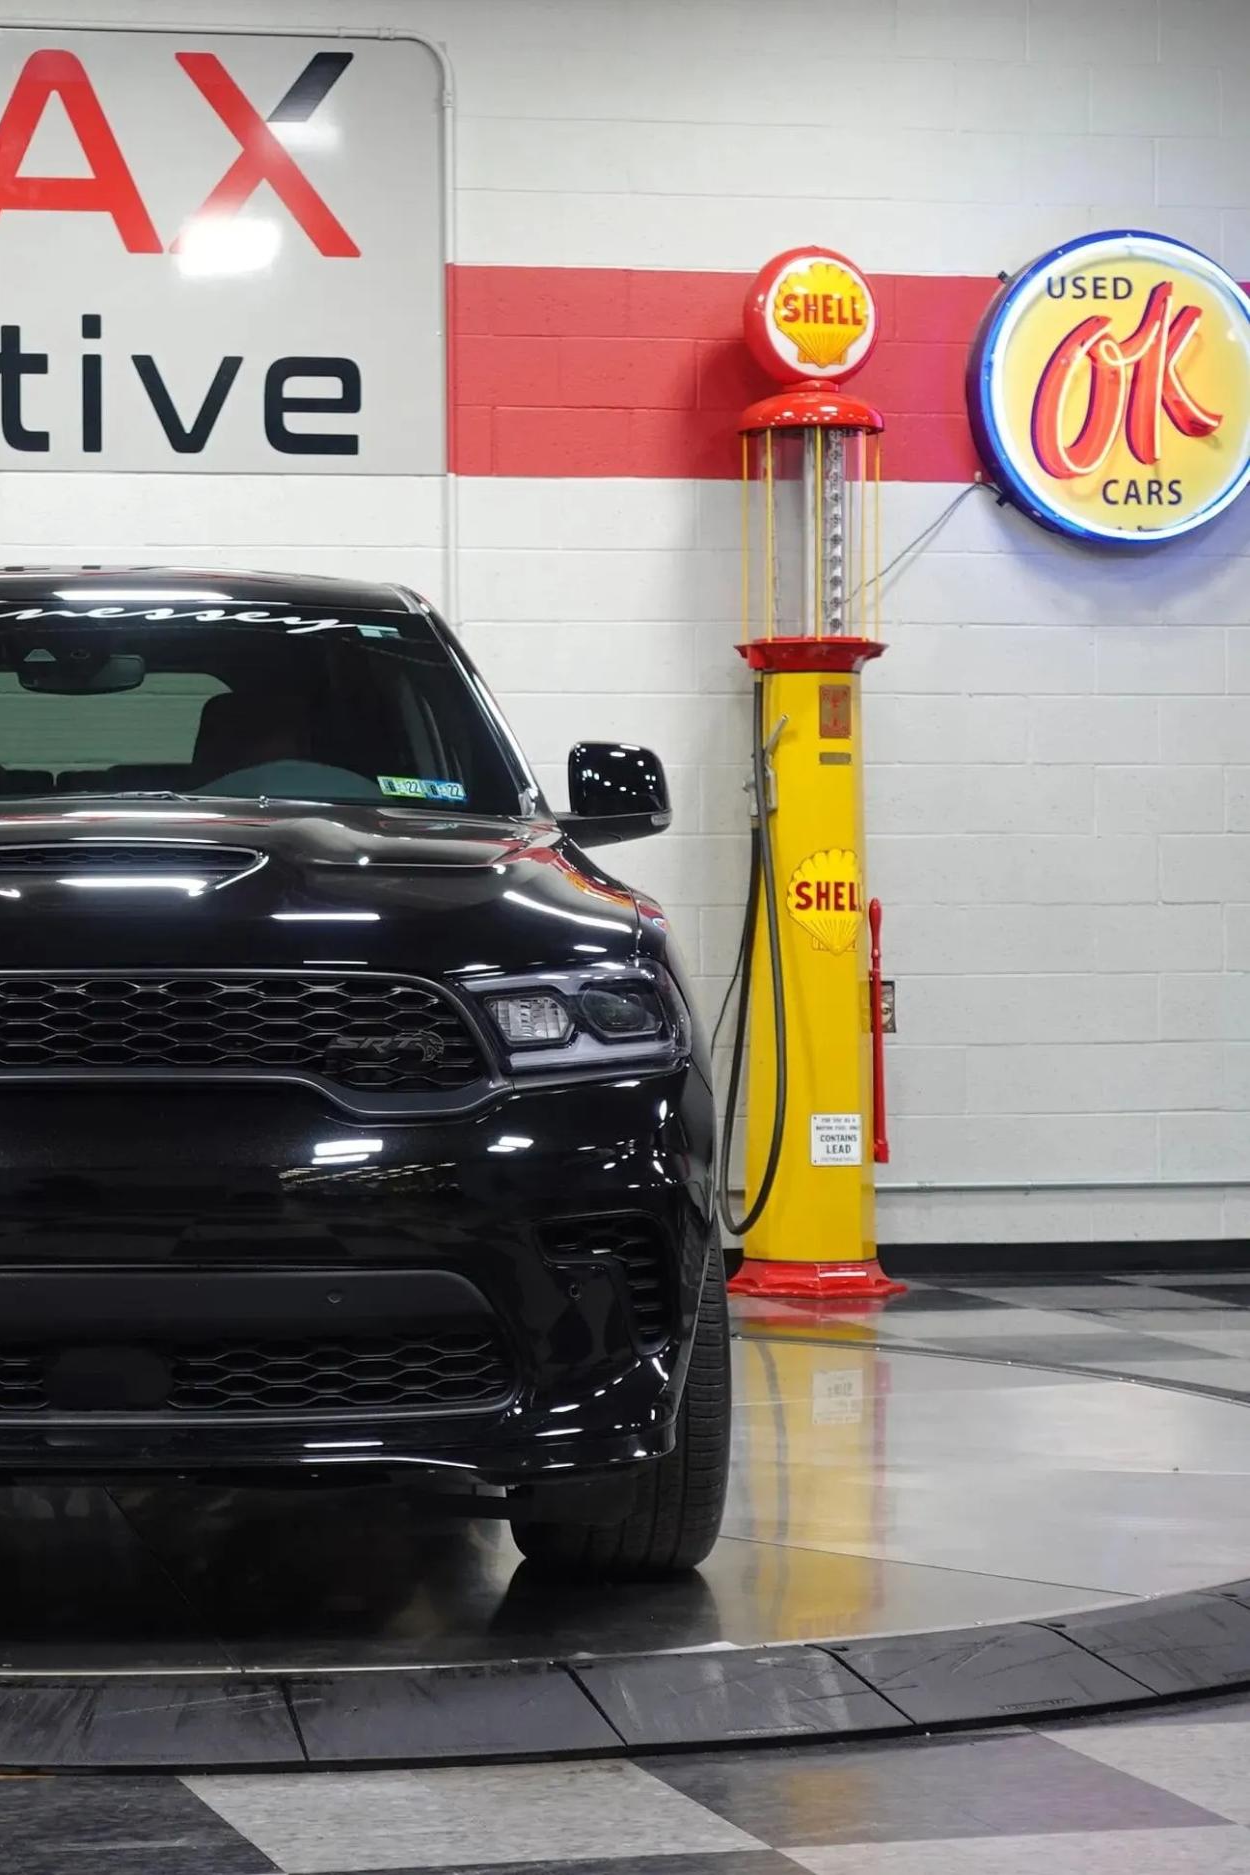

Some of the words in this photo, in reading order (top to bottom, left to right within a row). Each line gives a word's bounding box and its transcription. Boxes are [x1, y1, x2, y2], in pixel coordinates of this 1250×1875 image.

[1046, 276, 1133, 300] USED
[782, 294, 863, 326] SHELL
[1101, 479, 1183, 506] CARS
[328, 1036, 423, 1054] SRT
[820, 1134, 858, 1143] CONTAINS
[826, 1144, 852, 1154] LEAD
